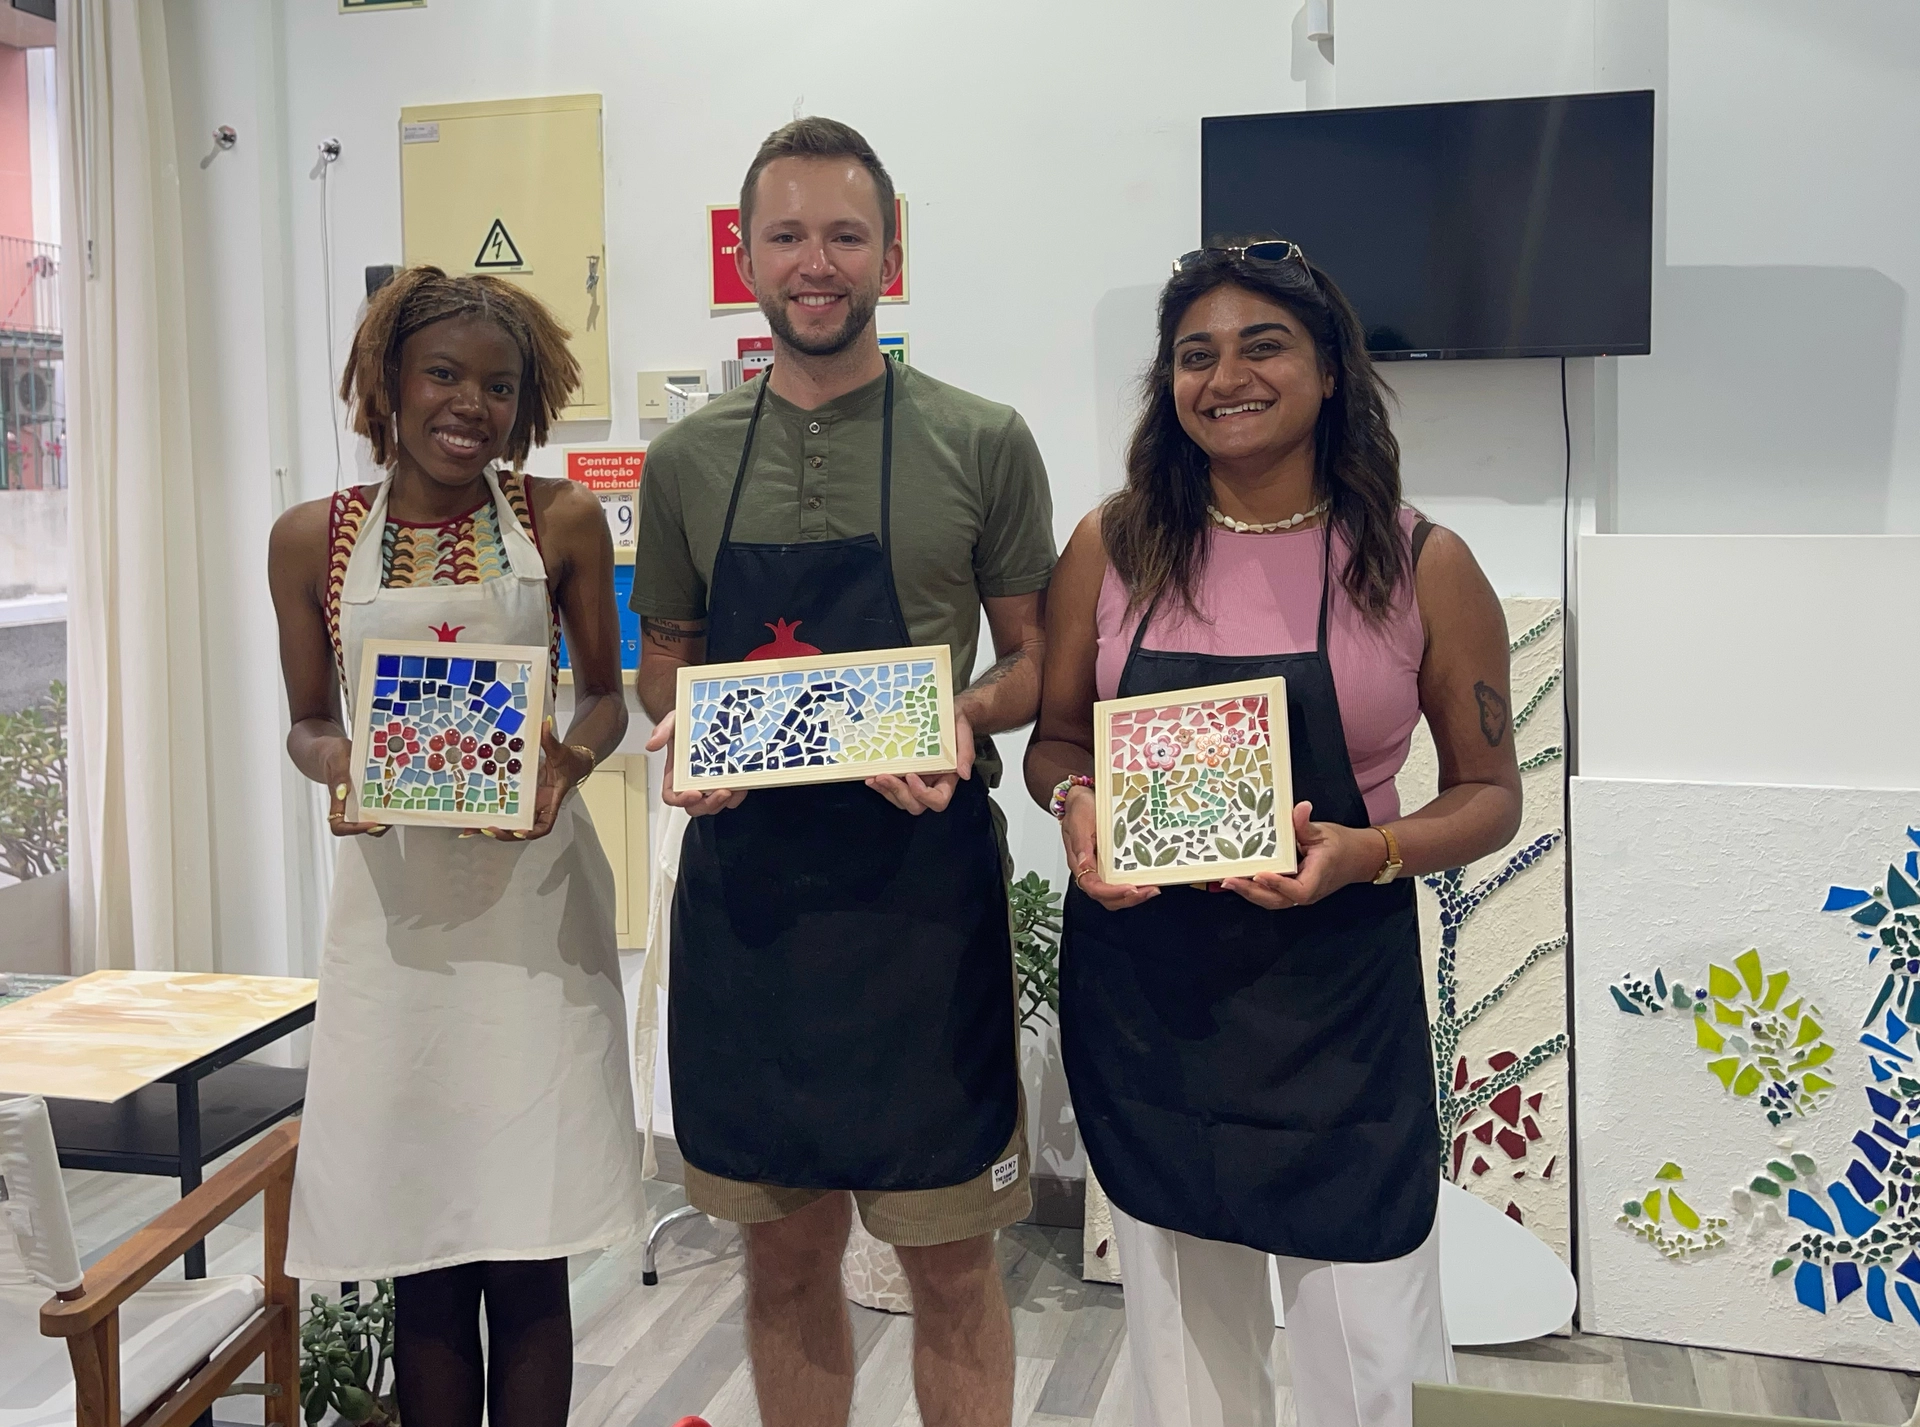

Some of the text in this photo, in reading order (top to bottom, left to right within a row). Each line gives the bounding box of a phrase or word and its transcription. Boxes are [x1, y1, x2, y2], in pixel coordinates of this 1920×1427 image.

[577, 456, 641, 466] Central de
[584, 467, 634, 479] deteção
[994, 1160, 1017, 1177] POINT
